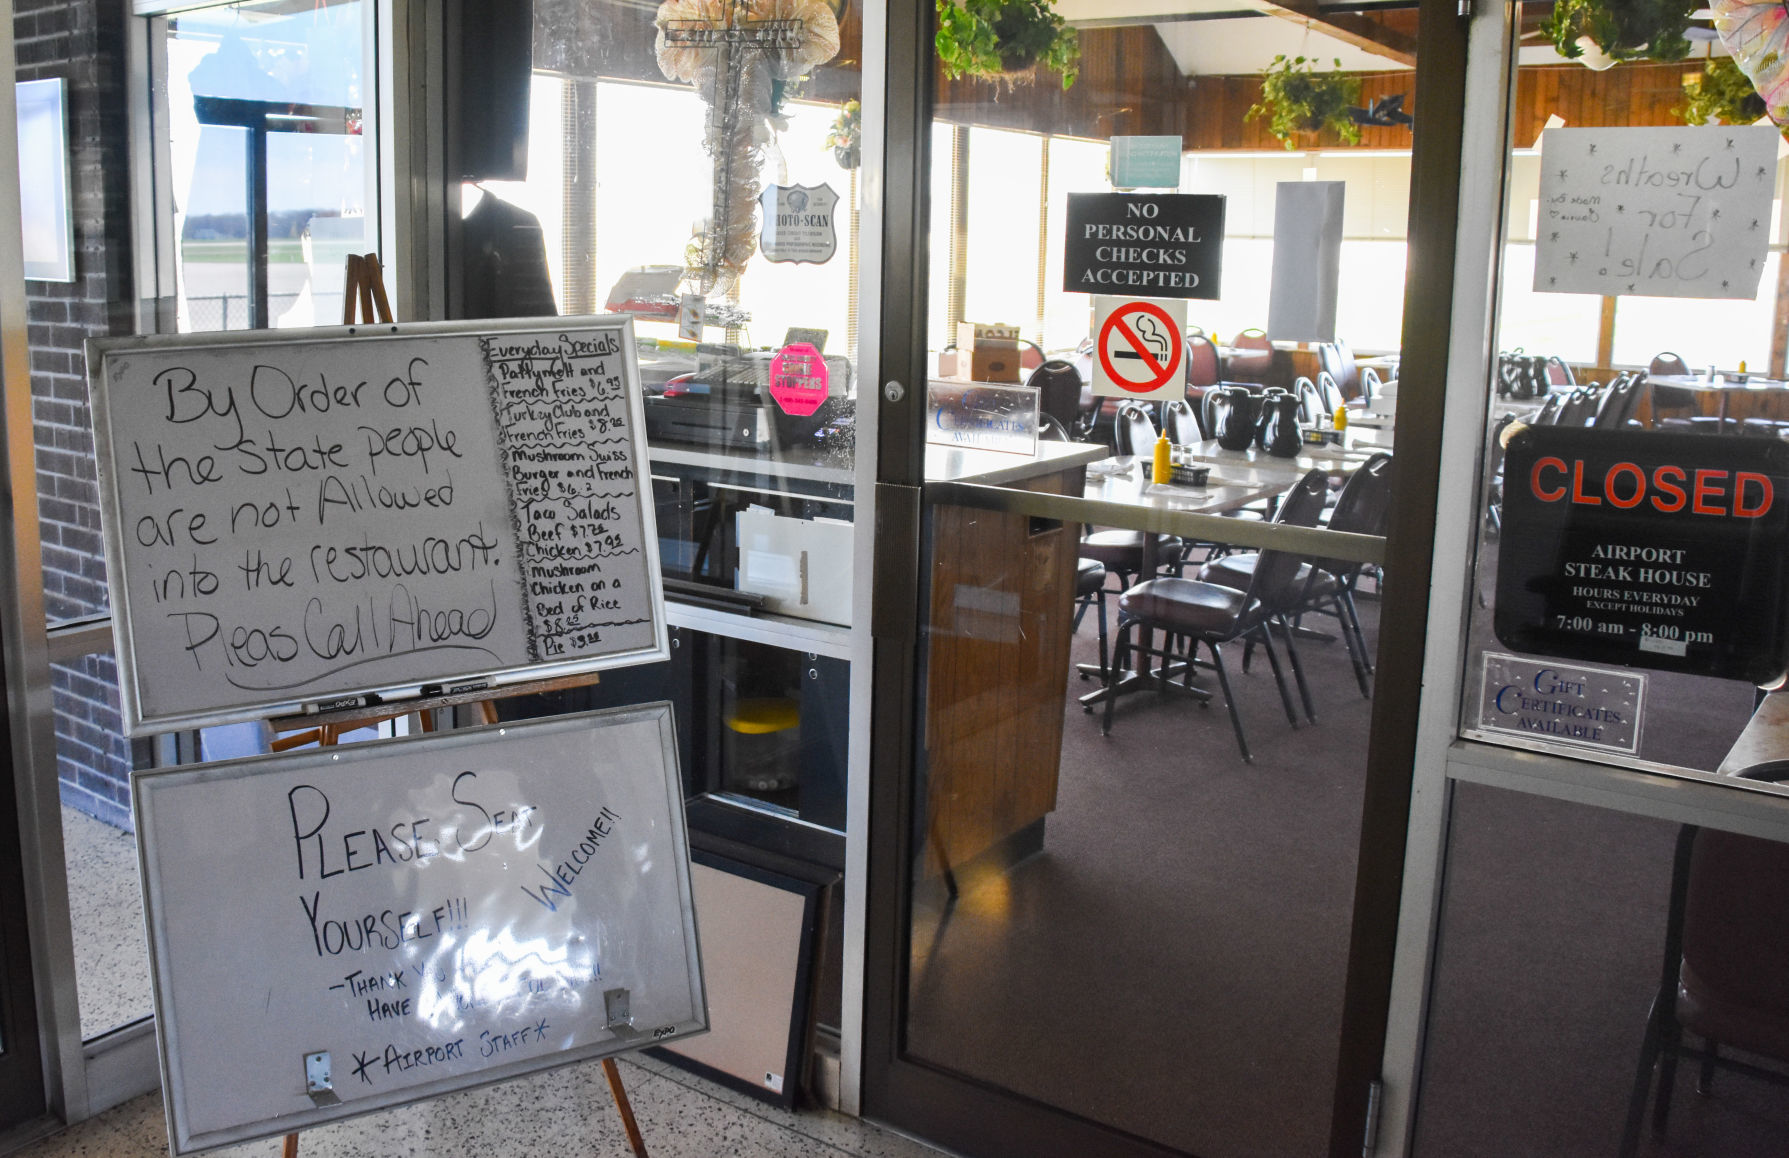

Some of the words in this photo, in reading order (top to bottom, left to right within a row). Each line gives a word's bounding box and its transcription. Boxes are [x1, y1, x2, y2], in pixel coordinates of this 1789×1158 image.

[1126, 203, 1159, 218] NO
[1084, 224, 1201, 243] PERSONAL
[1095, 246, 1187, 265] CHECKS
[1081, 268, 1200, 288] ACCEPTED
[488, 338, 564, 366] Everyday
[559, 333, 620, 358] Specials
[581, 361, 606, 377] and
[502, 380, 549, 399] French
[553, 379, 586, 398] Fries
[153, 366, 243, 450] By
[251, 365, 367, 419] Order
[384, 358, 428, 407] of
[584, 403, 610, 418] and
[505, 422, 553, 443] French
[555, 422, 586, 439] Fries
[131, 441, 223, 495] the
[237, 429, 349, 474] State
[512, 465, 560, 490] Burger
[567, 465, 594, 480] and
[596, 462, 634, 481] French
[1530, 456, 1774, 519] CLOSED
[136, 508, 218, 547] are
[232, 487, 300, 534] not
[319, 468, 454, 526] Allowed
[521, 500, 556, 524] Taco
[563, 500, 621, 521] Salads
[528, 523, 564, 542] Beef
[528, 540, 581, 557] Chicken
[1592, 544, 1686, 564] AIRPORT
[148, 553, 219, 603] into
[237, 549, 294, 591] the
[310, 520, 501, 583] restaurant.
[1565, 562, 1632, 581] STEAK
[1639, 568, 1712, 588] HOUSE
[531, 580, 585, 596] Chicken
[591, 580, 606, 591] on
[612, 578, 622, 589] a
[1573, 586, 1620, 599] HOURS
[1624, 590, 1701, 607] EVERYDAY
[536, 601, 564, 617] Bed
[572, 595, 587, 614] of
[590, 595, 621, 611] Rice
[1587, 600, 1627, 612] EXCEPT
[1630, 604, 1684, 616] HOLIDAYS
[166, 612, 298, 671] Pleas
[304, 597, 379, 660] Call
[389, 583, 497, 655] Ahead
[1557, 615, 1592, 631] 7:00
[1597, 620, 1624, 634] am
[1641, 622, 1679, 640] 8:00
[1684, 631, 1714, 644] pm
[543, 636, 565, 656] Pie
[1517, 716, 1601, 740] AVAILABLE
[367, 998, 411, 1021] HAVE
